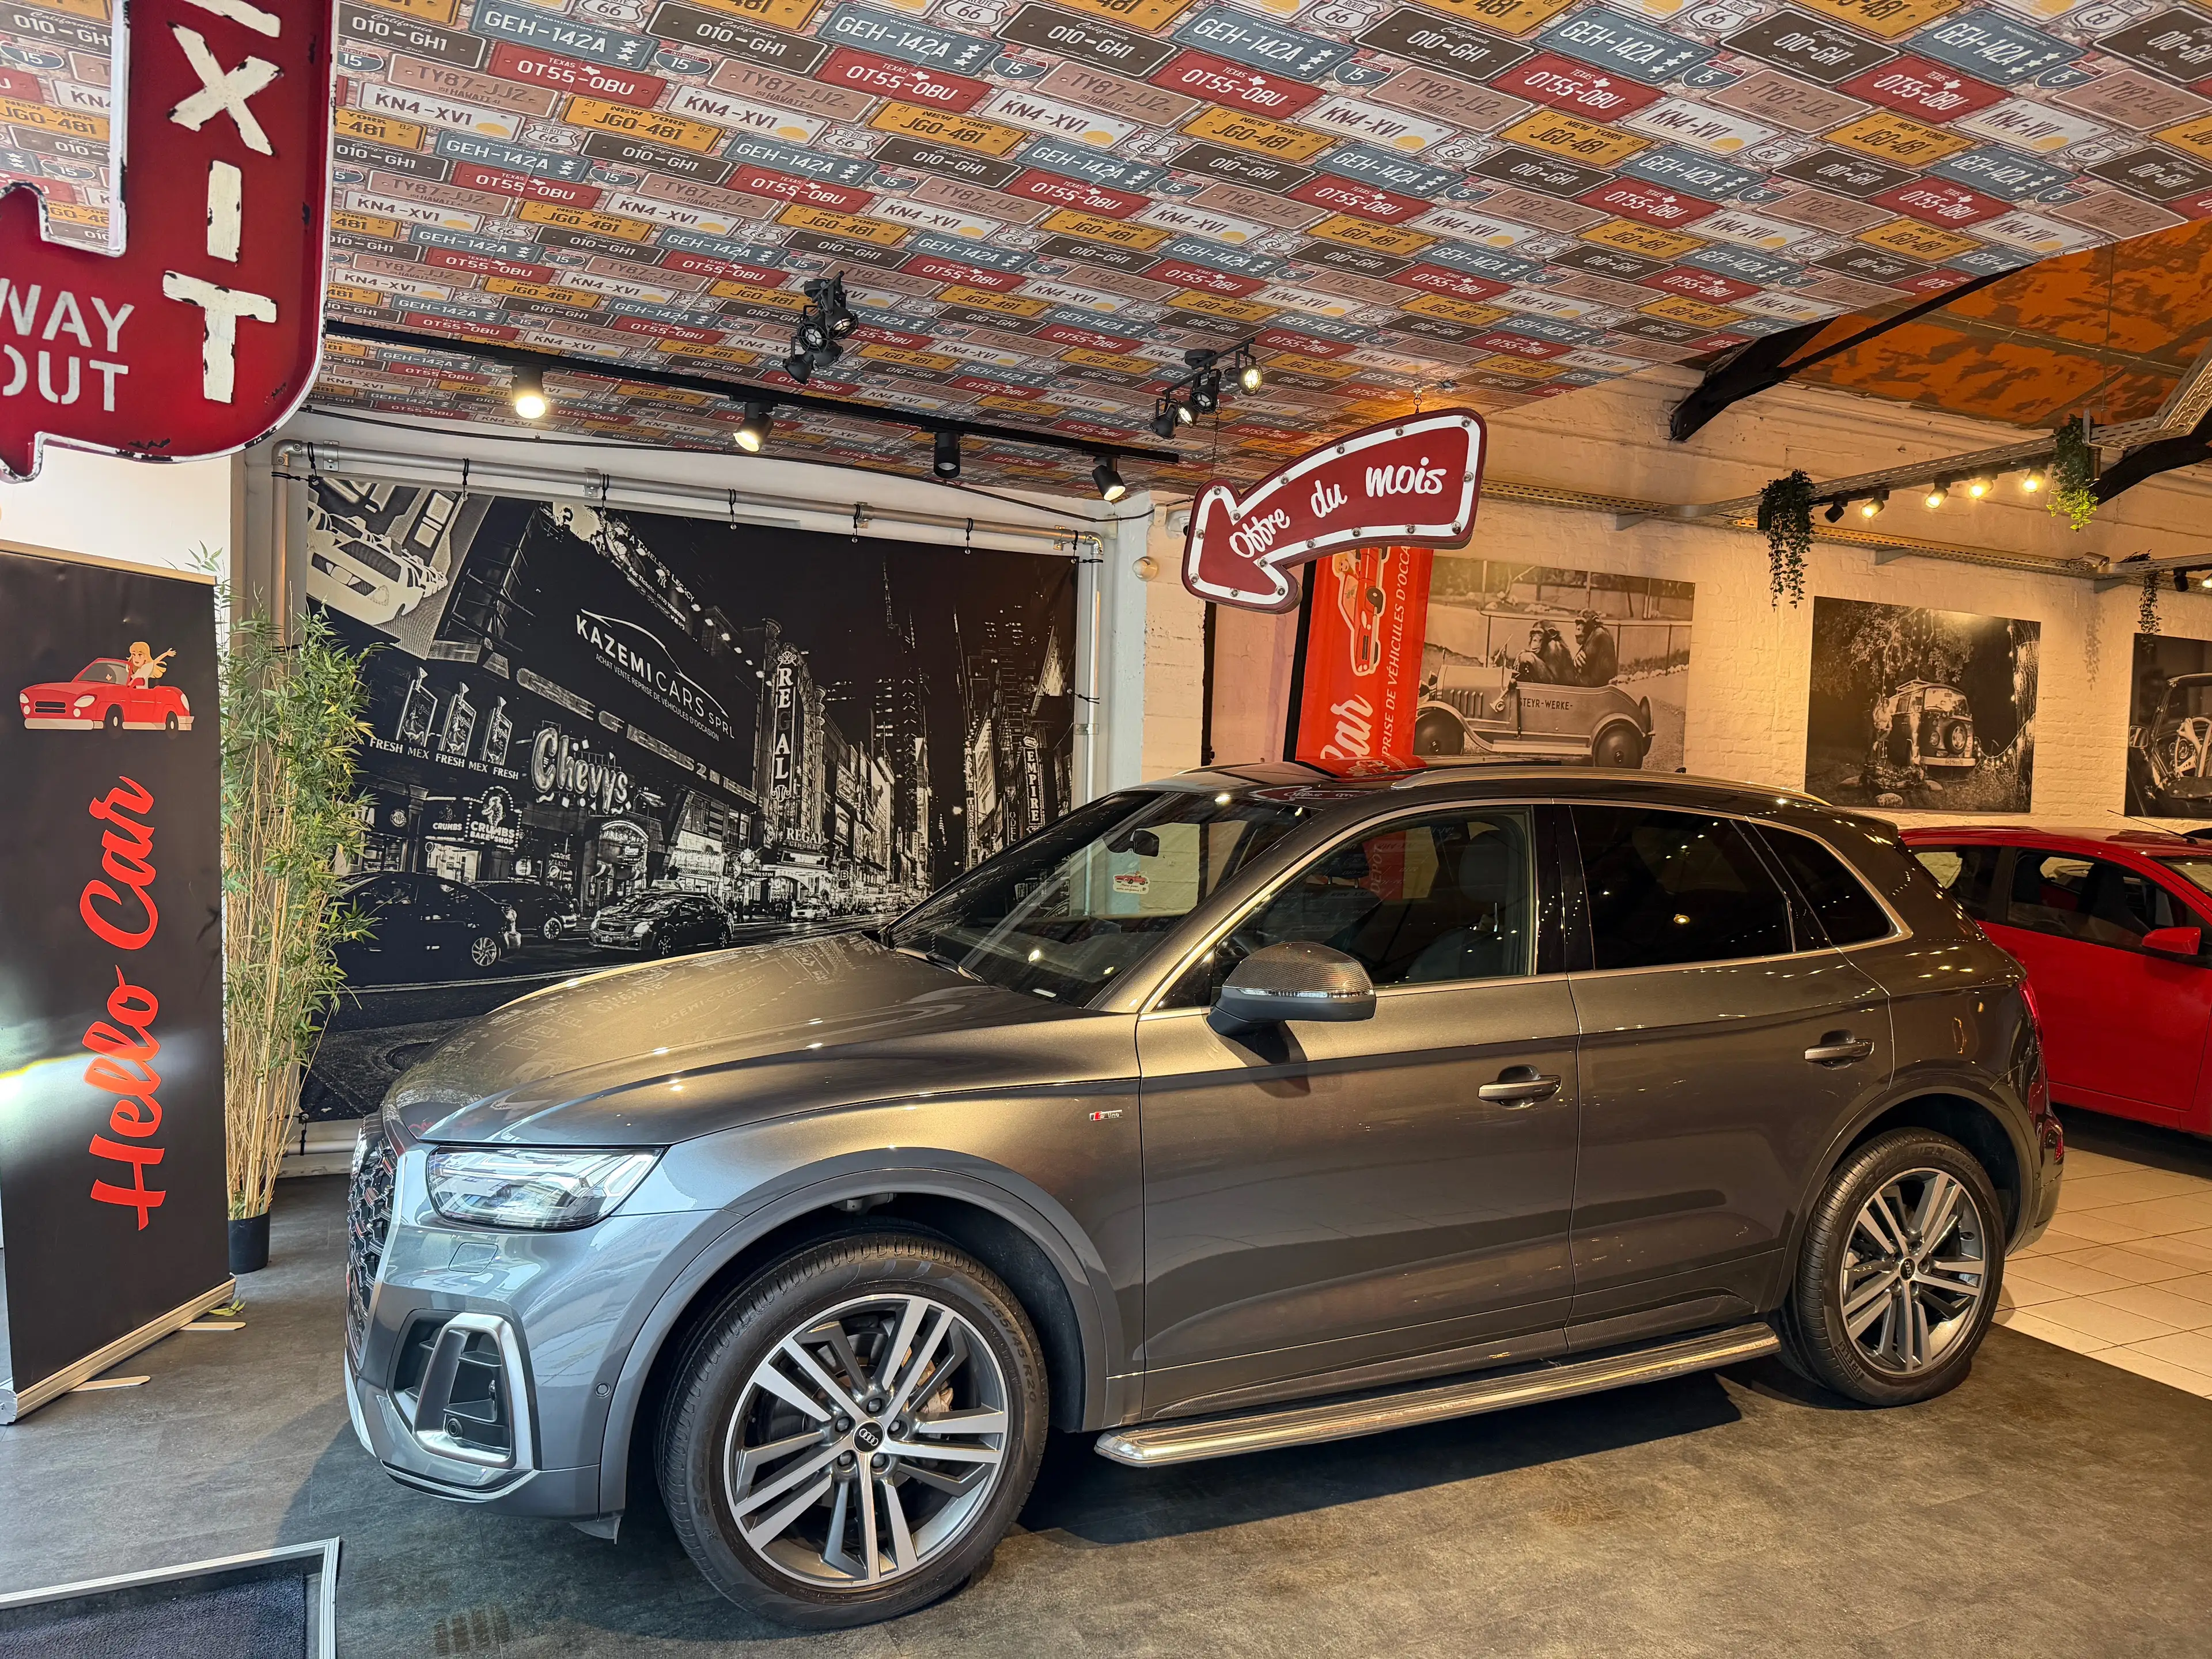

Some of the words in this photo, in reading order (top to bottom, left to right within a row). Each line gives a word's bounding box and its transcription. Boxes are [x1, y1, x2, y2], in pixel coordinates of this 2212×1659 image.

[891, 19, 944, 35] WASHINGTON
[1323, 10, 1353, 23] 66
[485, 12, 605, 52] GEH-142A
[720, 21, 778, 39] California
[835, 16, 951, 58] GEH-142A
[1191, 18, 1305, 62] GEH-142A
[1556, 21, 1666, 64] GEH-142A
[1623, 24, 1668, 41] WASHINGTON
[1811, 29, 1858, 47] California
[1929, 22, 2036, 65] GEH-142A
[549, 58, 577, 68] TEXAS
[670, 58, 691, 70] 15
[1003, 62, 1026, 74] 15
[1222, 67, 1249, 77] TEXAS
[418, 66, 527, 101] TY87-JJ2
[743, 70, 846, 106] TY87-JJ2
[1691, 70, 1719, 83] 15
[1070, 73, 1172, 111] TY87-JJ2
[1406, 78, 1504, 114] TY87-JJ2
[1748, 81, 1843, 116] TY87-JJ2
[376, 94, 472, 125] KN4-XV1
[684, 96, 778, 128] KN4-XV1
[921, 111, 953, 120] NEW
[959, 119, 994, 130] YORK
[998, 100, 1090, 132] KN4-XV1
[1318, 107, 1409, 137] KN4-XV1
[1238, 118, 1270, 127] NEW
[1274, 126, 1306, 137] YORK
[1645, 109, 1734, 140] KN4-XV1
[446, 141, 547, 169] GEH-142A
[835, 138, 857, 146] 66
[1031, 147, 1126, 179] GEH-142A
[1331, 152, 1423, 184] GEH-142A
[1636, 156, 1726, 185] GEH-142A
[392, 179, 485, 204] TY87-JJ2
[665, 181, 753, 207] TY87-JJ2
[1164, 183, 1185, 192] 15
[358, 199, 440, 221] KN4-XV1
[883, 204, 963, 228] KN4-XV1
[1219, 190, 1304, 217] TY87-JJ2
[1152, 210, 1230, 232] KN4-XV1
[1425, 215, 1502, 237] KN4-XV1
[419, 232, 506, 253] GEH-142A
[918, 238, 1000, 262] GEH-142A
[1430, 248, 1509, 271] GEH-142A
[570, 277, 641, 295] KN4-XV1
[399, 300, 476, 317] GEH-142A
[1265, 291, 1332, 308] KN4-XV1
[1229, 506, 1290, 560] Offre
[1310, 481, 1348, 518] du
[1365, 457, 1448, 498] mois
[1388, 606, 1404, 685] VÉHICULES
[576, 614, 652, 683] KAZEMI
[656, 671, 705, 718] CARS
[709, 711, 735, 739] SPRL
[596, 653, 613, 669] ACHAT
[613, 662, 631, 683] VENTE
[631, 676, 653, 697] REPRISE
[653, 691, 661, 703] DE
[661, 696, 689, 722] VÉHICULES
[689, 717, 719, 742] D'OCCASION
[1385, 688, 1397, 711] DE
[775, 668, 793, 779] REGAL
[369, 737, 403, 754] FRESH
[408, 747, 430, 760] MEX
[435, 753, 465, 768] FRESH
[468, 760, 488, 773] MEX
[493, 767, 519, 781] FRESH
[531, 727, 628, 815] Chevys
[1027, 751, 1039, 822] EMPIRE
[432, 822, 463, 831] CRUMBS
[470, 820, 516, 839] CRUMBS
[470, 831, 491, 841] BAKE
[494, 836, 514, 846] SHOP
[786, 827, 824, 845] REGAL
[79, 775, 159, 950] Car
[82, 964, 168, 1231] Hello
[1023, 1364, 1037, 1403] R20
